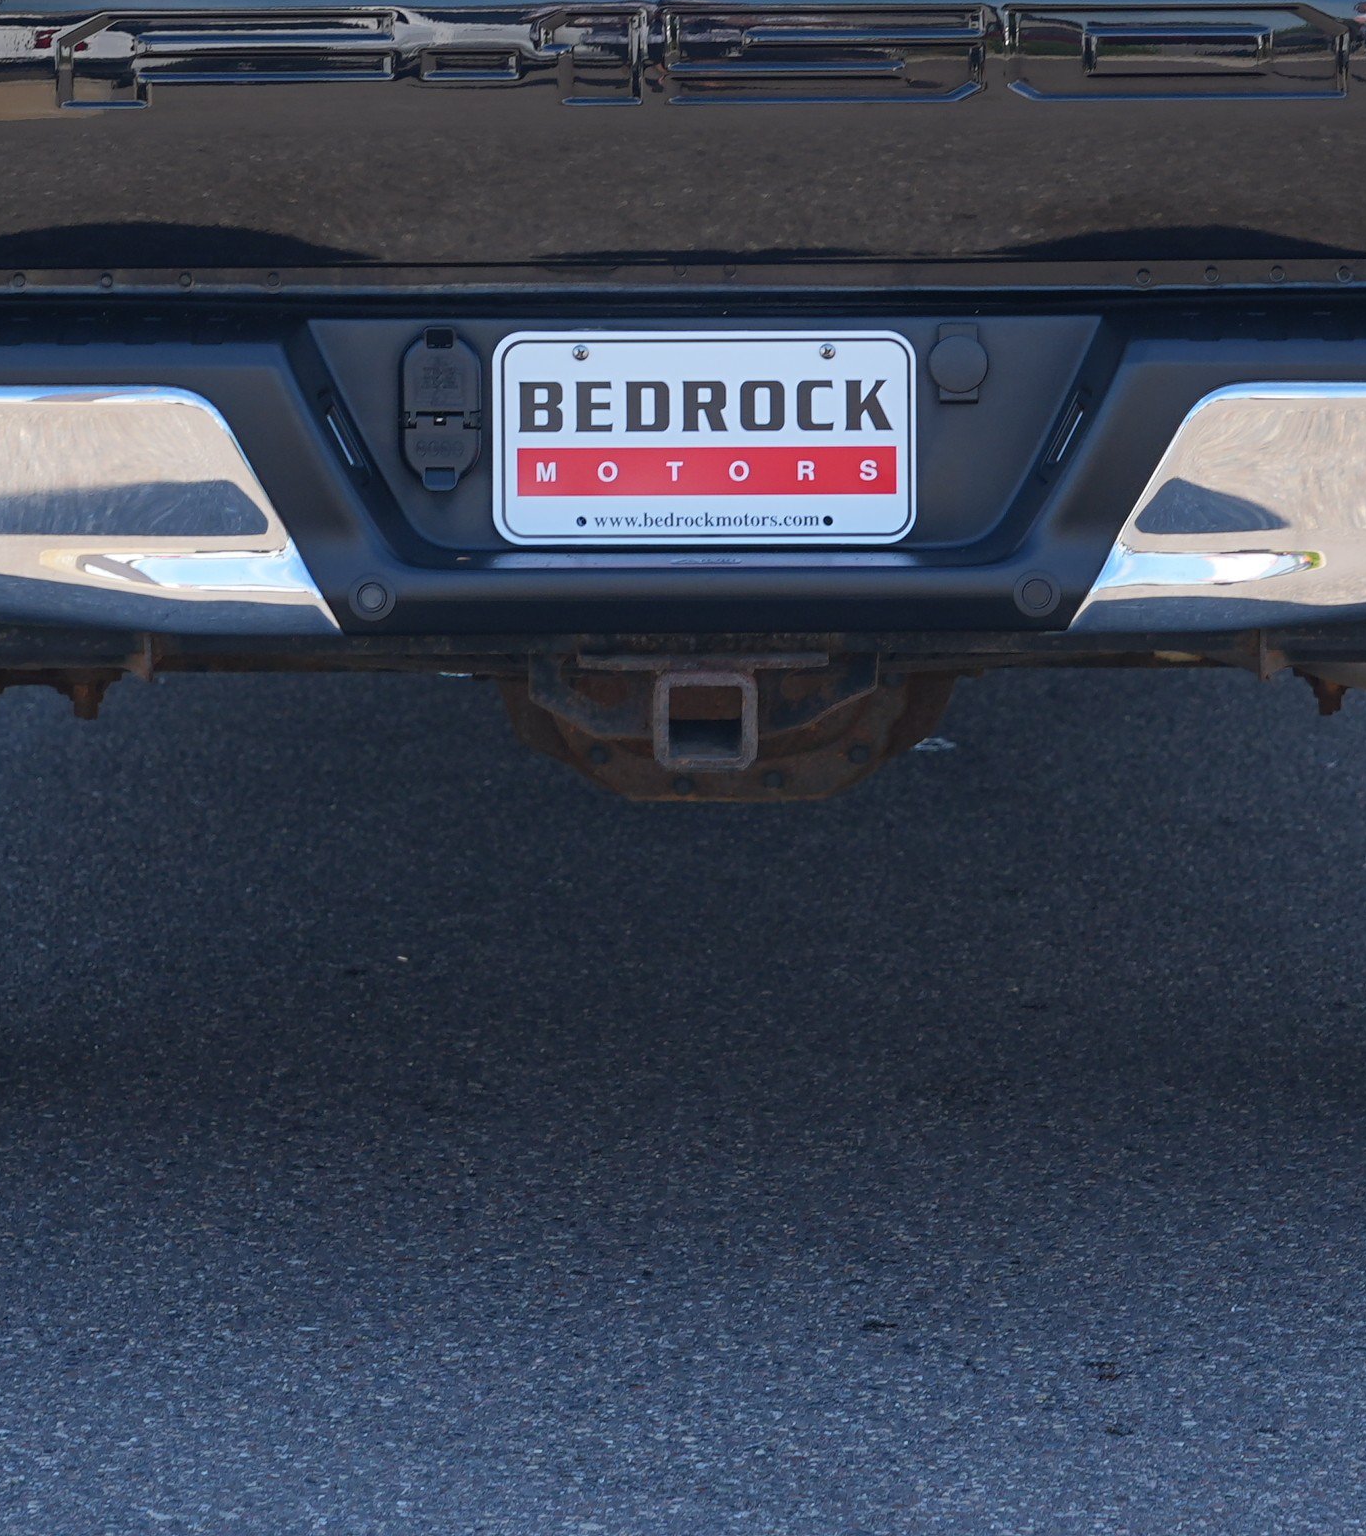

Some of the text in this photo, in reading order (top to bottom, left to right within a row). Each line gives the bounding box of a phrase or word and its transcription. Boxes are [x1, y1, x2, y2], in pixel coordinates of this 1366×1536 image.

[518, 379, 894, 433] BEDROCK
[536, 459, 878, 483] MOTORS
[593, 512, 820, 528] www.bedrockmotors.com
